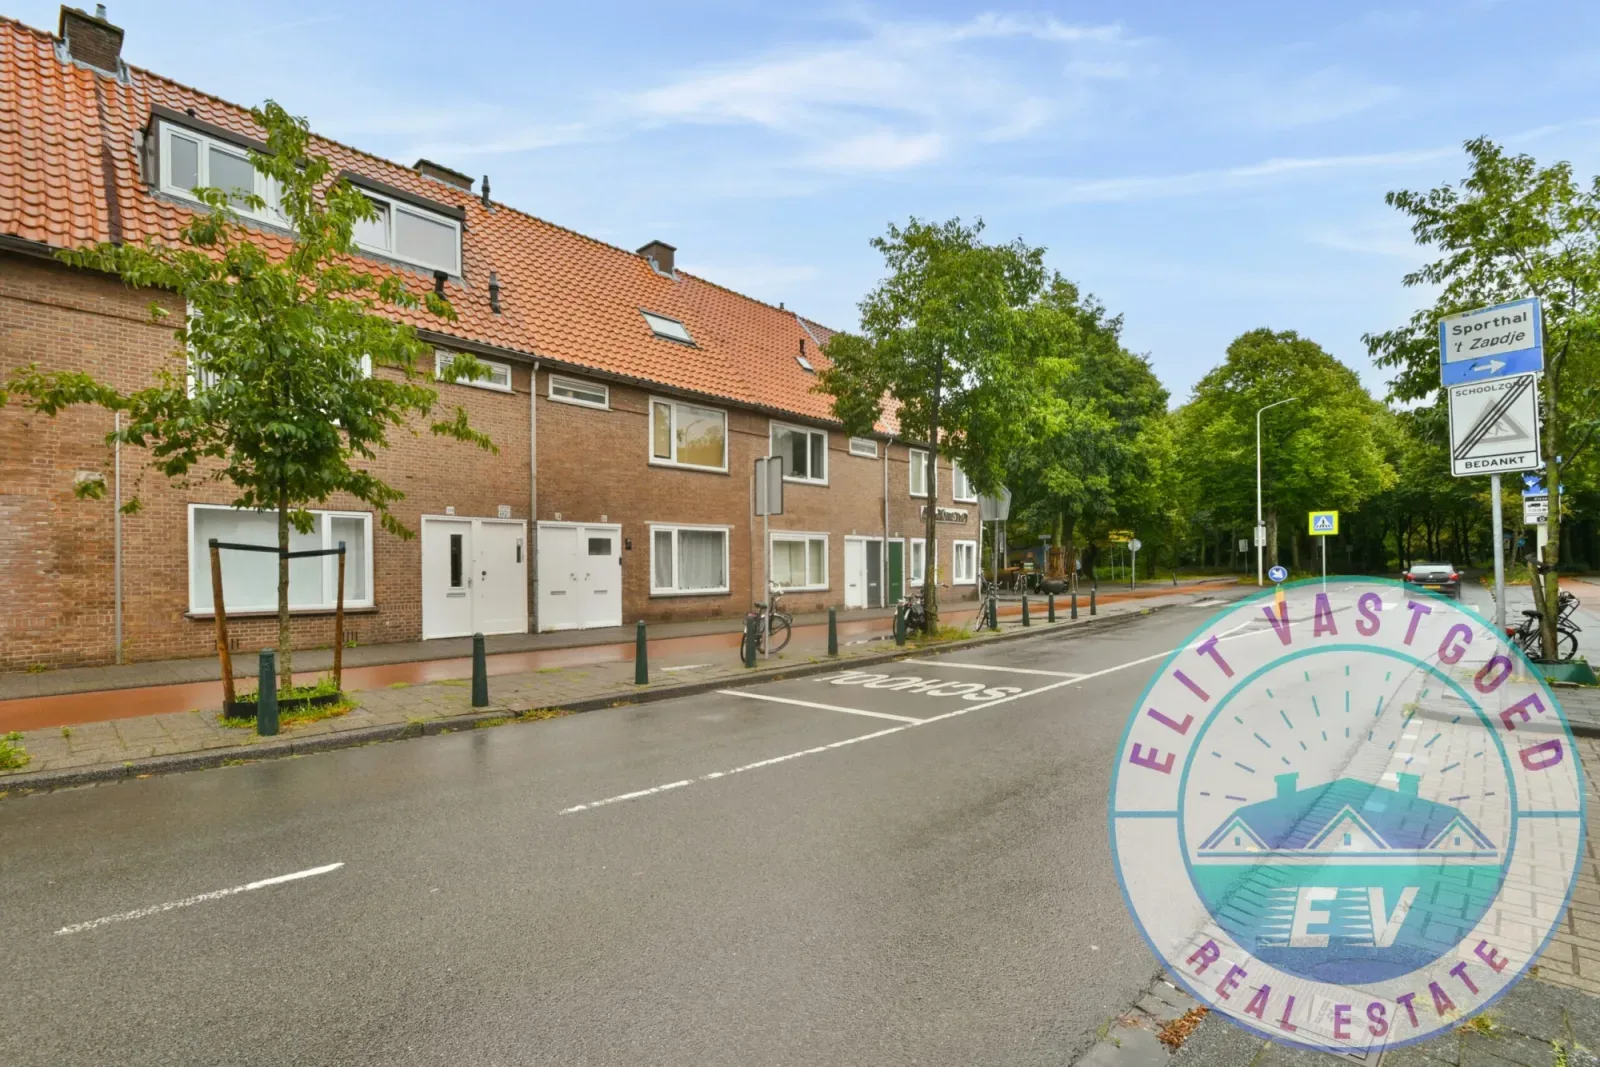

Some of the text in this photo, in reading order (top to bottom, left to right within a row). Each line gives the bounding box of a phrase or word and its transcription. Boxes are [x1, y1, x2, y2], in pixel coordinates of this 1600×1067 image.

[1452, 311, 1528, 336] Sporthal
[1465, 456, 1525, 469] BEDANKT
[812, 670, 1022, 701] SCHOOL
